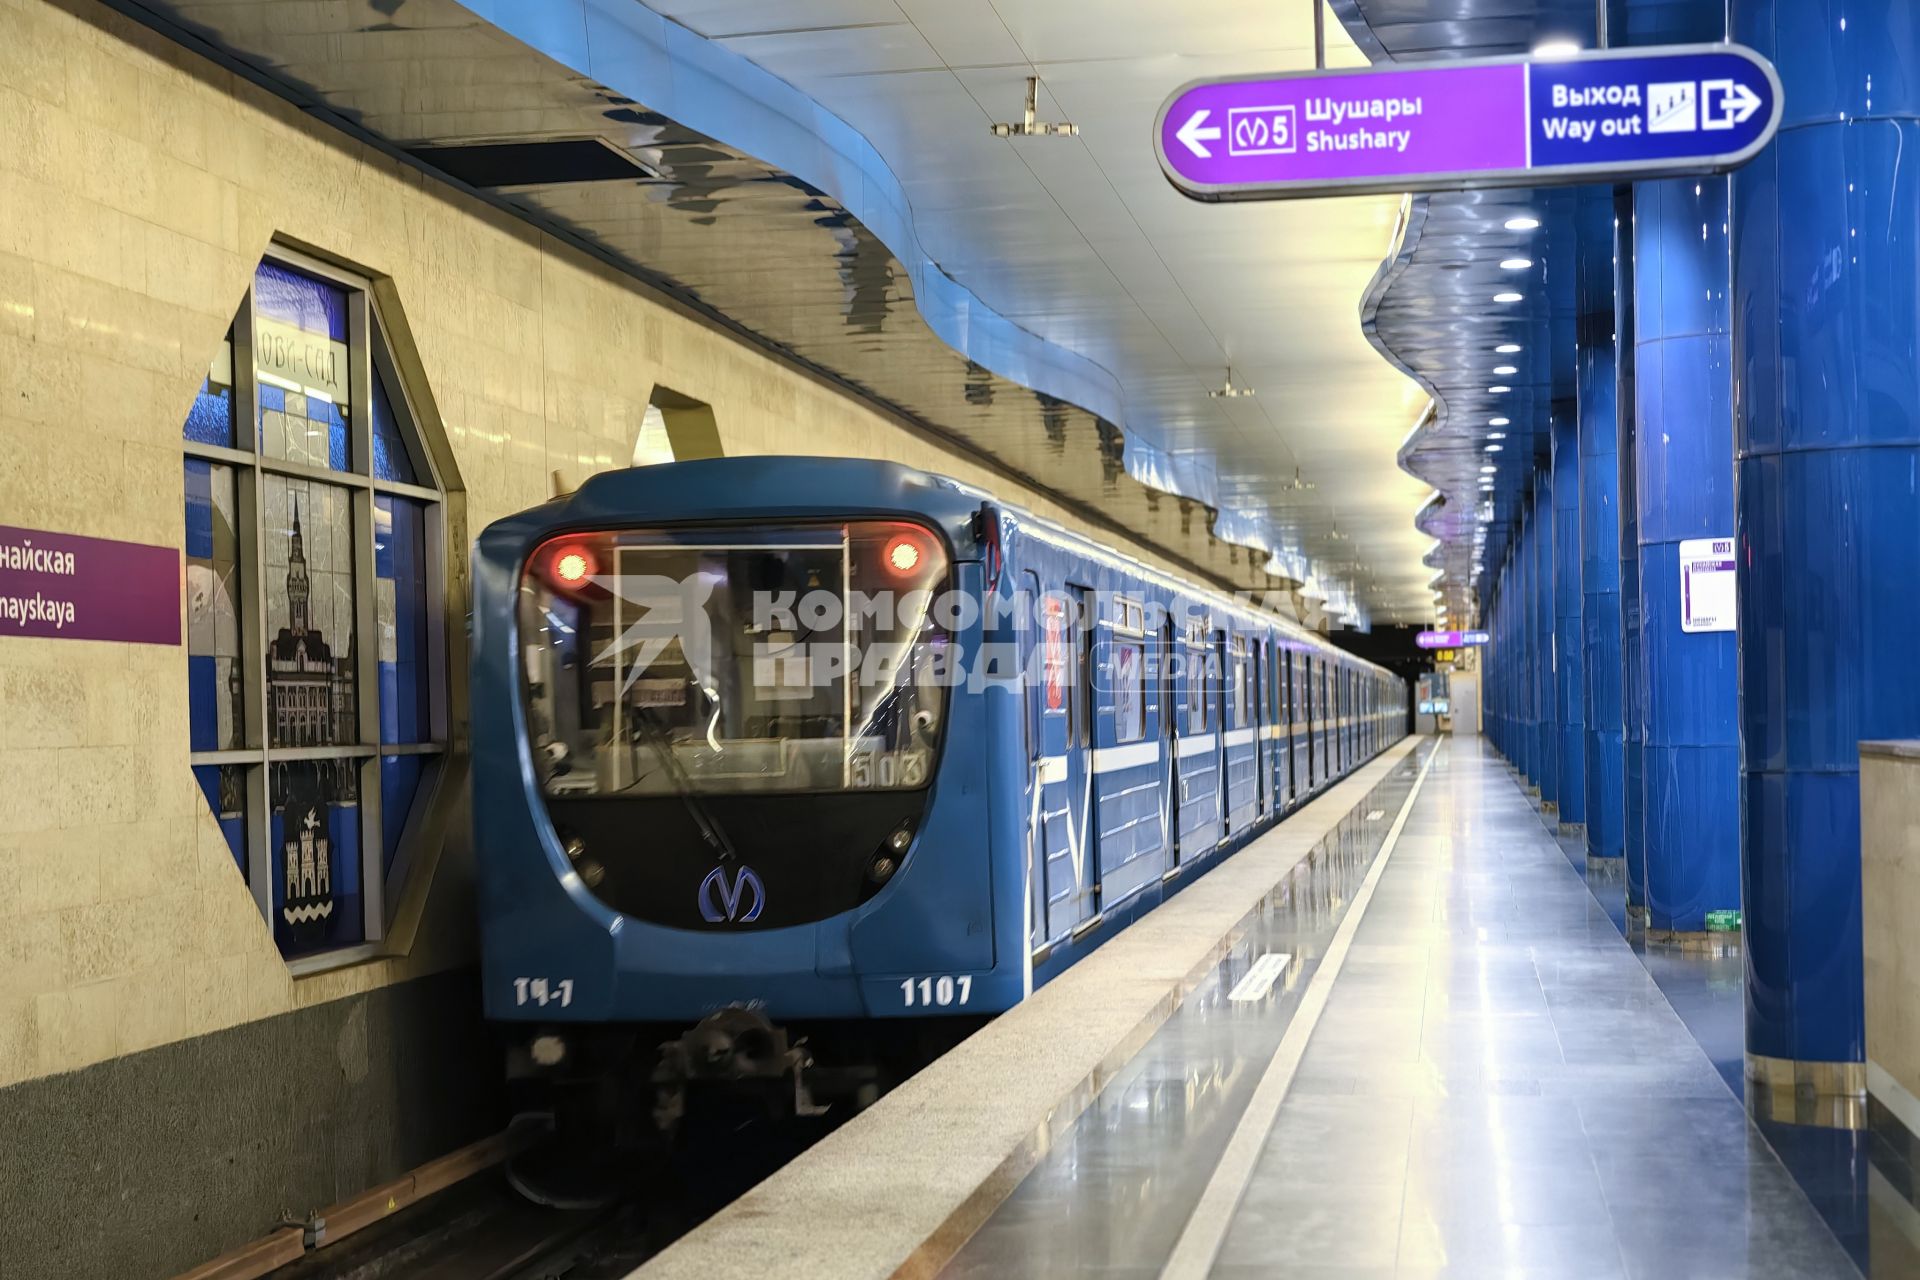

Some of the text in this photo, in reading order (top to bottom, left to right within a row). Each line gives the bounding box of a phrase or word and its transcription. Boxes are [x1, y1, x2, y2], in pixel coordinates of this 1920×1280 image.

[1305, 97, 1422, 125] Шушары
[1552, 84, 1641, 108] Выход
[1272, 115, 1289, 146] 5
[1306, 128, 1411, 152] Shushary
[1542, 114, 1642, 143] Way out
[0, 539, 75, 576] найская
[0, 592, 75, 629] nayskaya
[900, 974, 973, 1007] 1107
